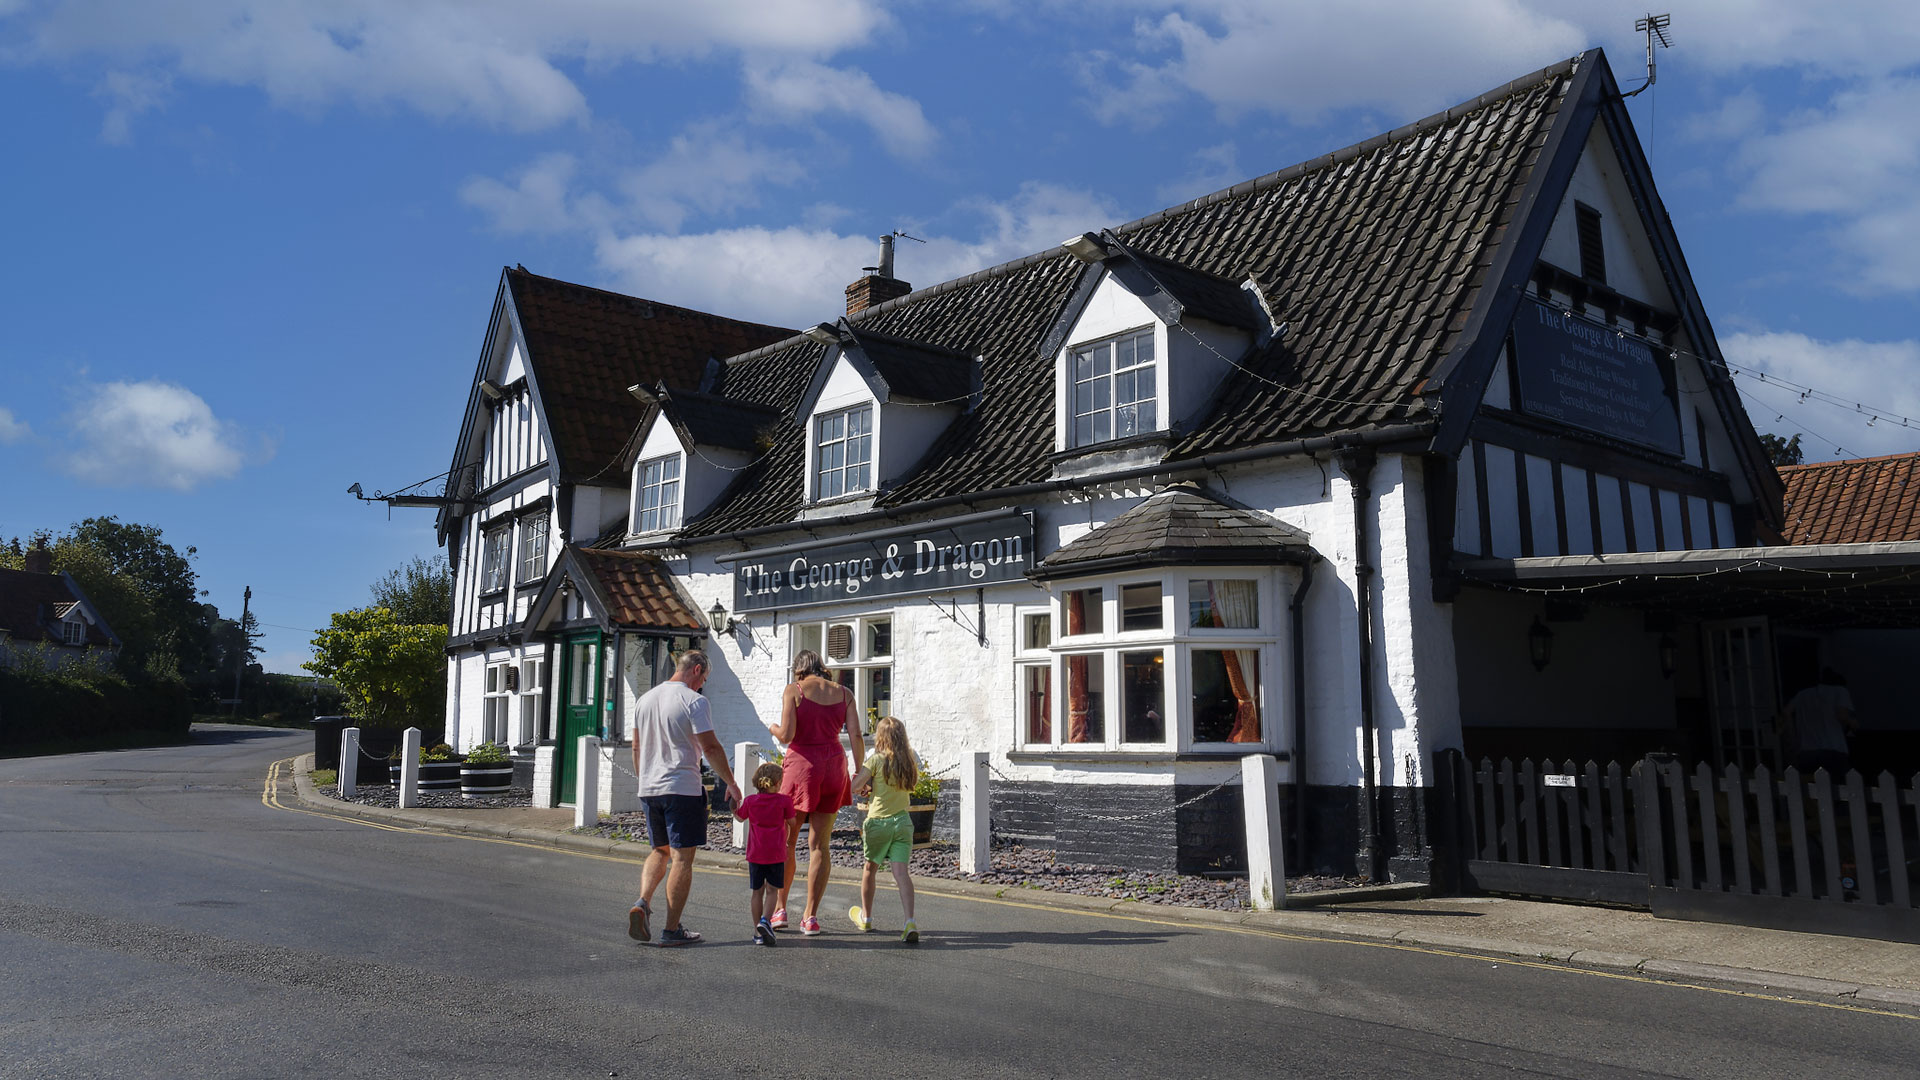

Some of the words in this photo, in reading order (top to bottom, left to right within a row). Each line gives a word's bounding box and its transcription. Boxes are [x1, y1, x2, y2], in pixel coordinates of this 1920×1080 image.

[1536, 304, 1560, 329] The
[1562, 314, 1601, 347] George
[1604, 330, 1614, 349] &
[1617, 336, 1653, 363] Dragon
[1560, 353, 1577, 370] Real
[1550, 368, 1588, 392] Traditional
[1589, 383, 1609, 400] Home
[1610, 388, 1634, 407] Cooked
[1634, 396, 1651, 412] Food
[1559, 390, 1584, 410] Served
[1584, 399, 1605, 416] Seven
[1606, 404, 1622, 422] Days
[1623, 411, 1629, 423] A
[741, 563, 782, 597] The
[788, 556, 874, 594] George
[882, 543, 905, 580] &
[914, 535, 1024, 579] Dragon
